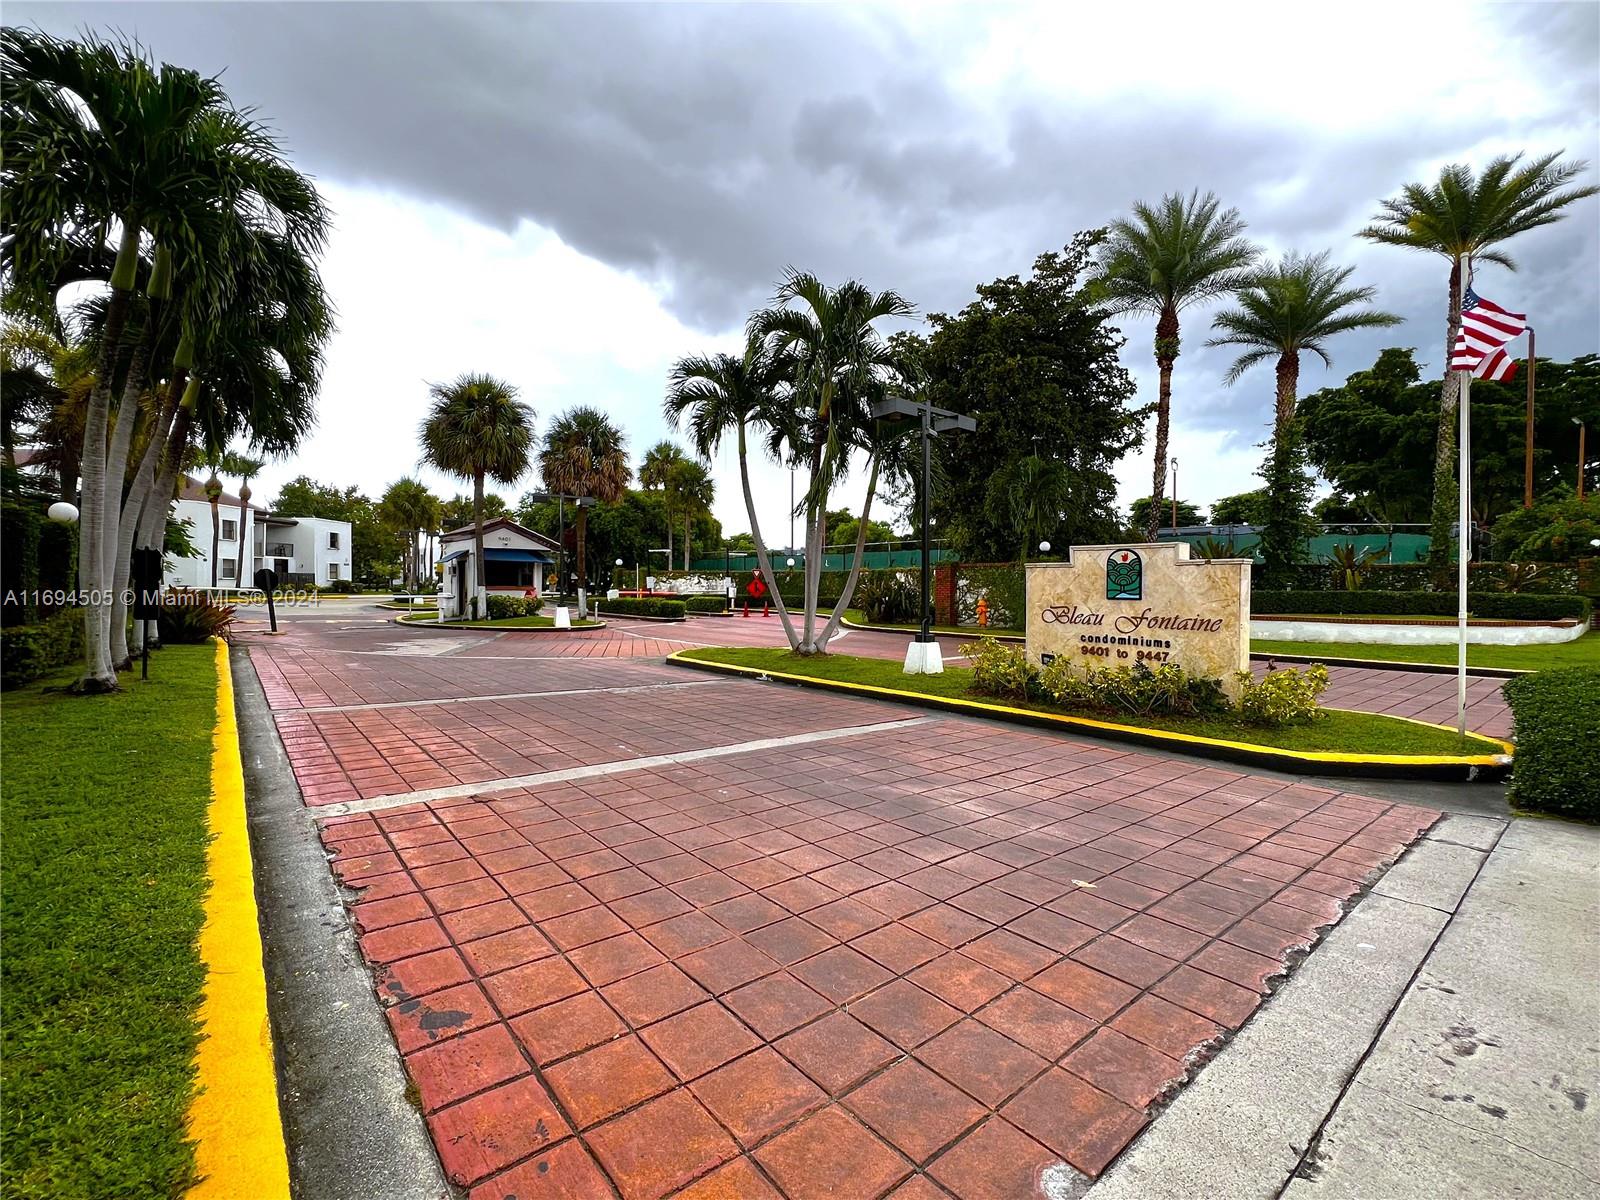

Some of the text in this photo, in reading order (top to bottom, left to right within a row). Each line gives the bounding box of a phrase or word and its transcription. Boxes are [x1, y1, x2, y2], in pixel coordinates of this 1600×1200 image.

[1041, 605, 1223, 634] Bleau Fontaine
[1080, 634, 1171, 649] condominiums
[1081, 645, 1170, 662] 9401 to 9447
